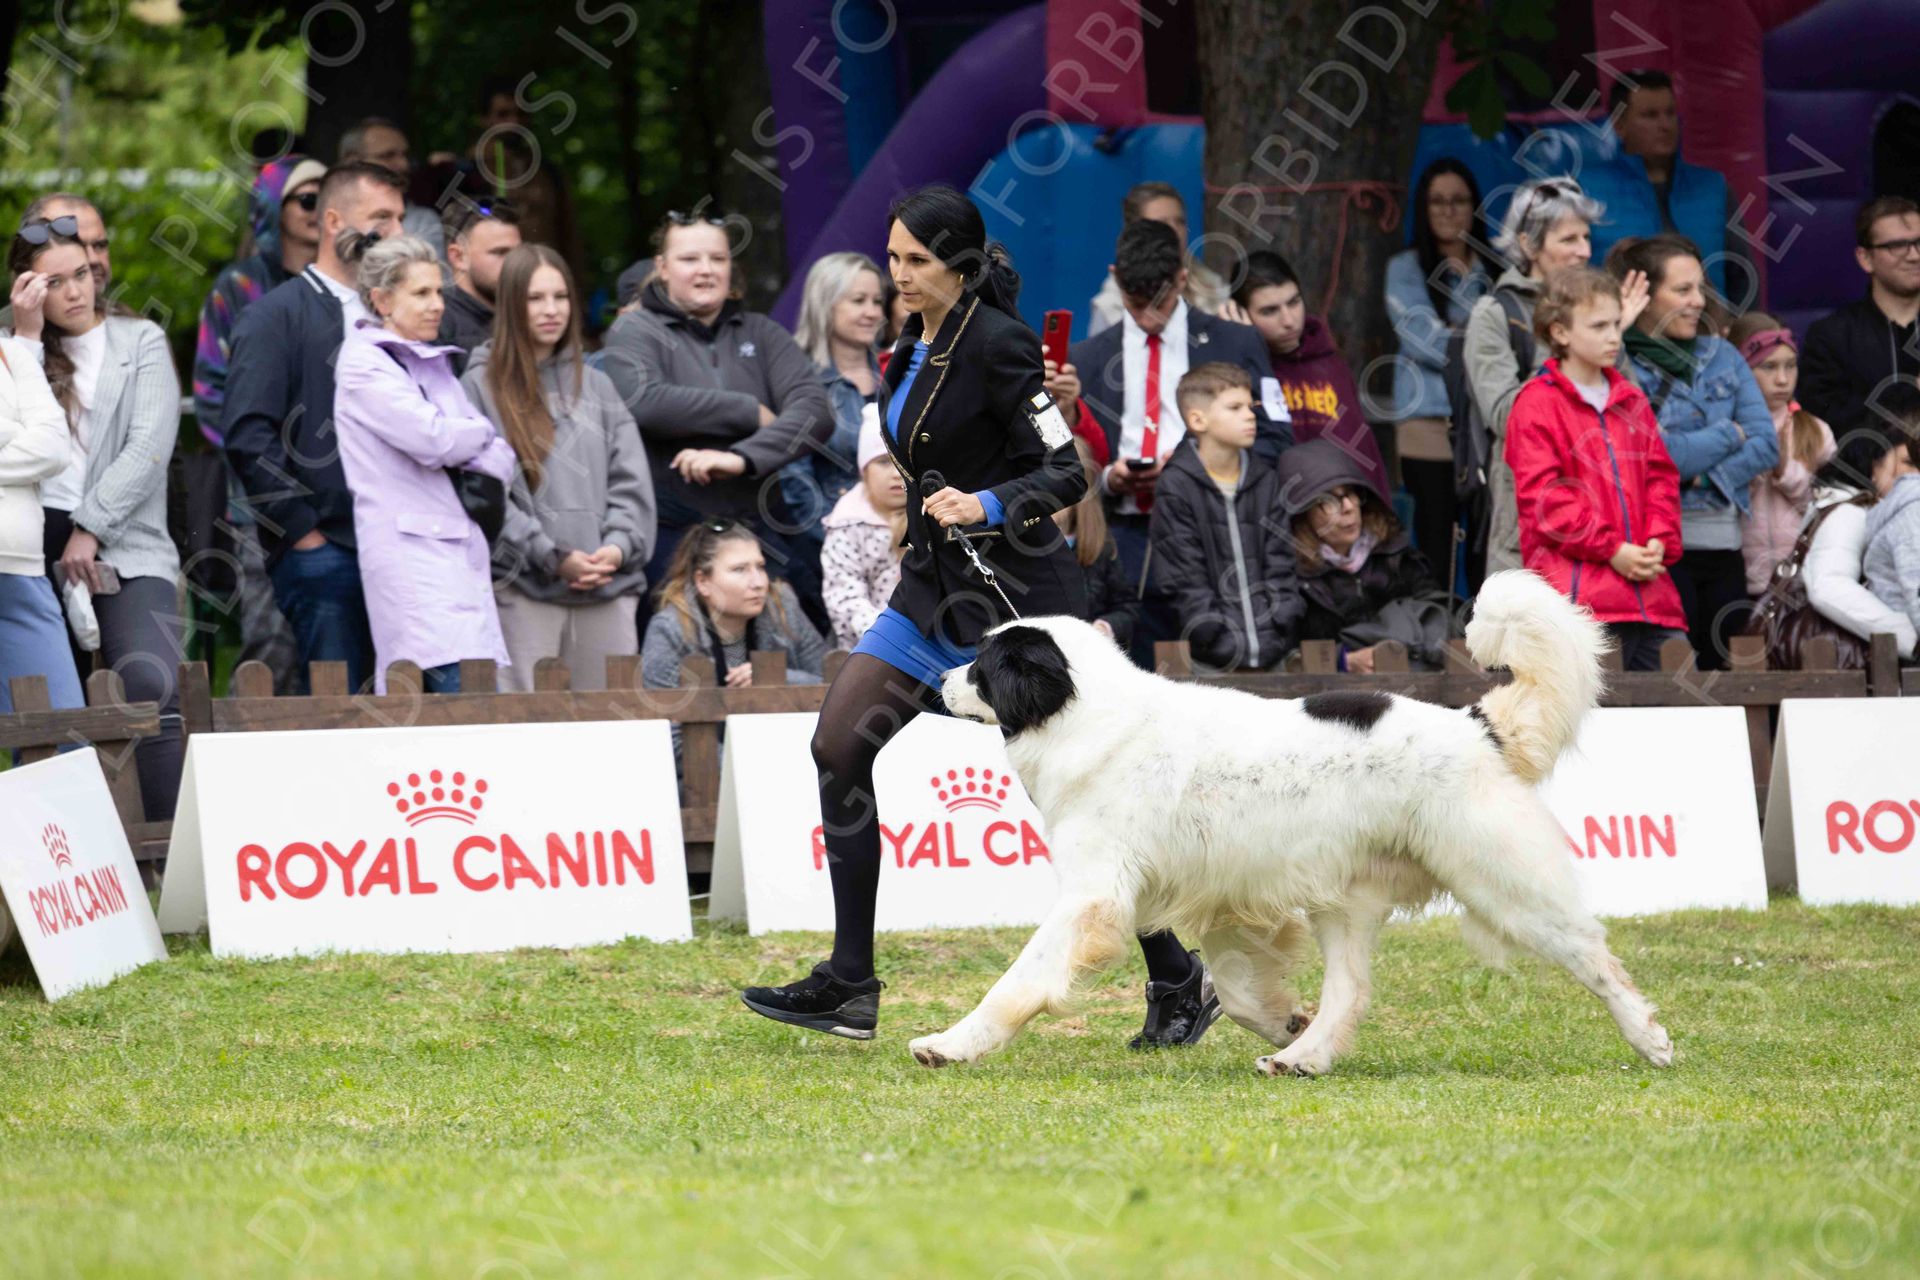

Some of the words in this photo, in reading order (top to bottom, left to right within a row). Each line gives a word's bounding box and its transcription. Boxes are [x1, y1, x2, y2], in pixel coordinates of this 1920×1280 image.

[811, 821, 970, 870] RYAL
[1825, 799, 1920, 854] RO
[236, 836, 439, 902] ROYAL
[452, 828, 655, 892] CANIN
[28, 878, 84, 938] ROYAL
[73, 863, 129, 922] CANIN
